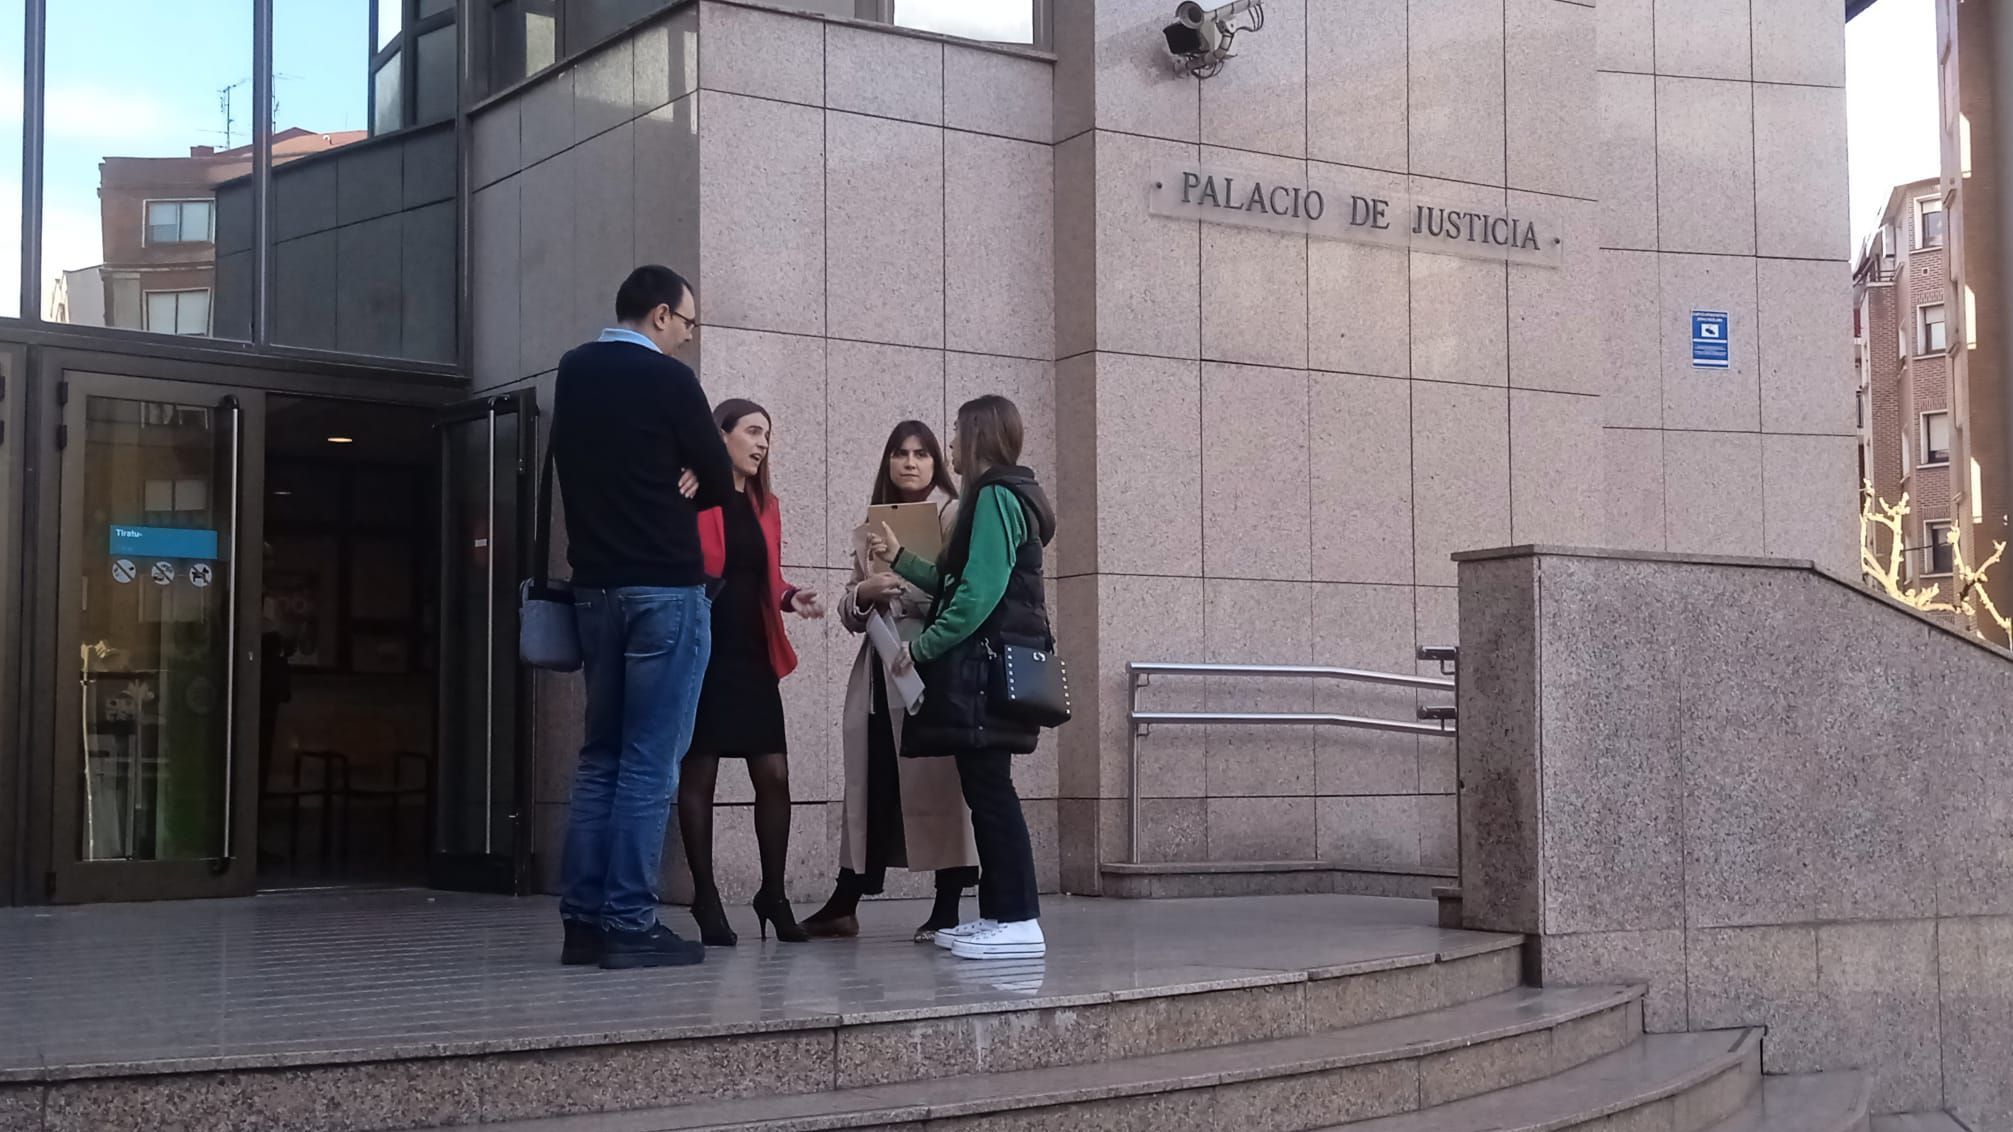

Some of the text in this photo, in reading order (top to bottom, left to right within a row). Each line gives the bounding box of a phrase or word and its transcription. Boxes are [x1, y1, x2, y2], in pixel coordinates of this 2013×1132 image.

[1182, 172, 1541, 250] PALACIO DE JUSTICIA
